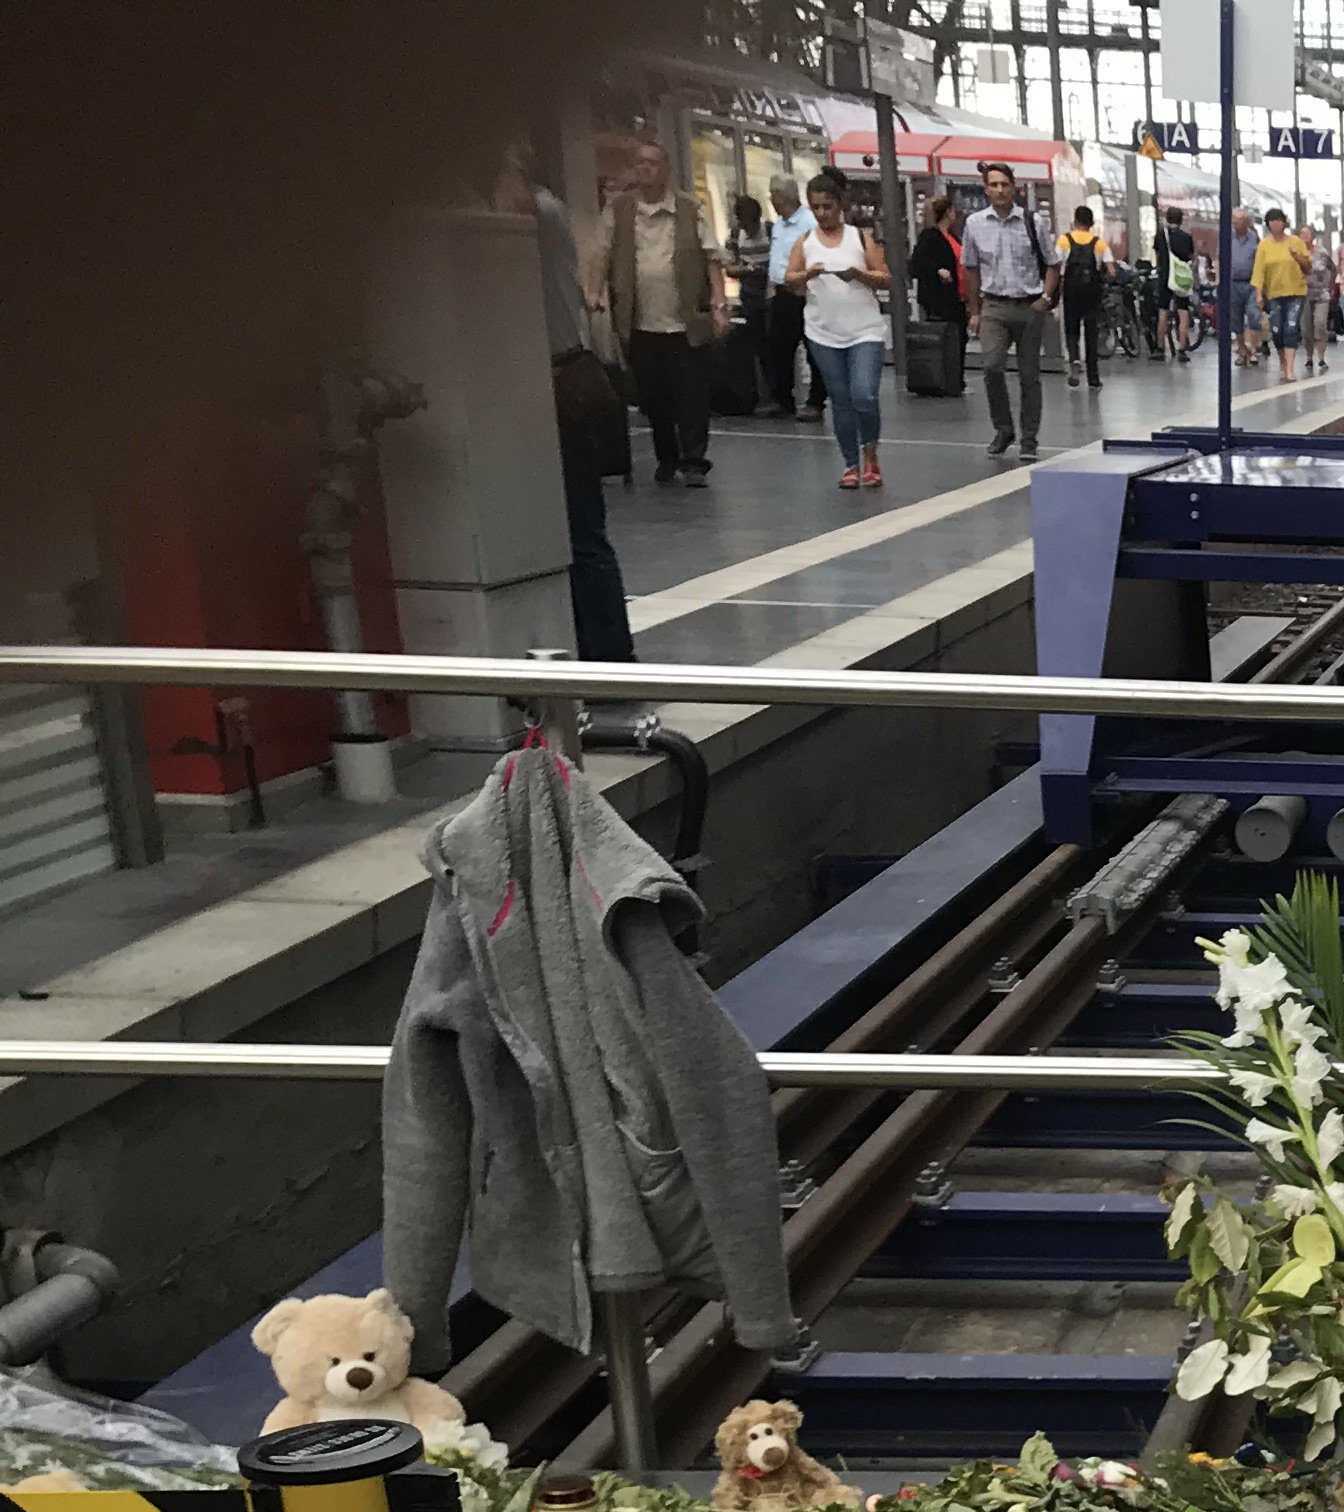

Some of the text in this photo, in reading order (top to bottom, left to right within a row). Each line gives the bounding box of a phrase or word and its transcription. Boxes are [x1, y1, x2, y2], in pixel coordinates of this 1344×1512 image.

[1171, 122, 1190, 148] A
[1277, 128, 1328, 153] A 7
